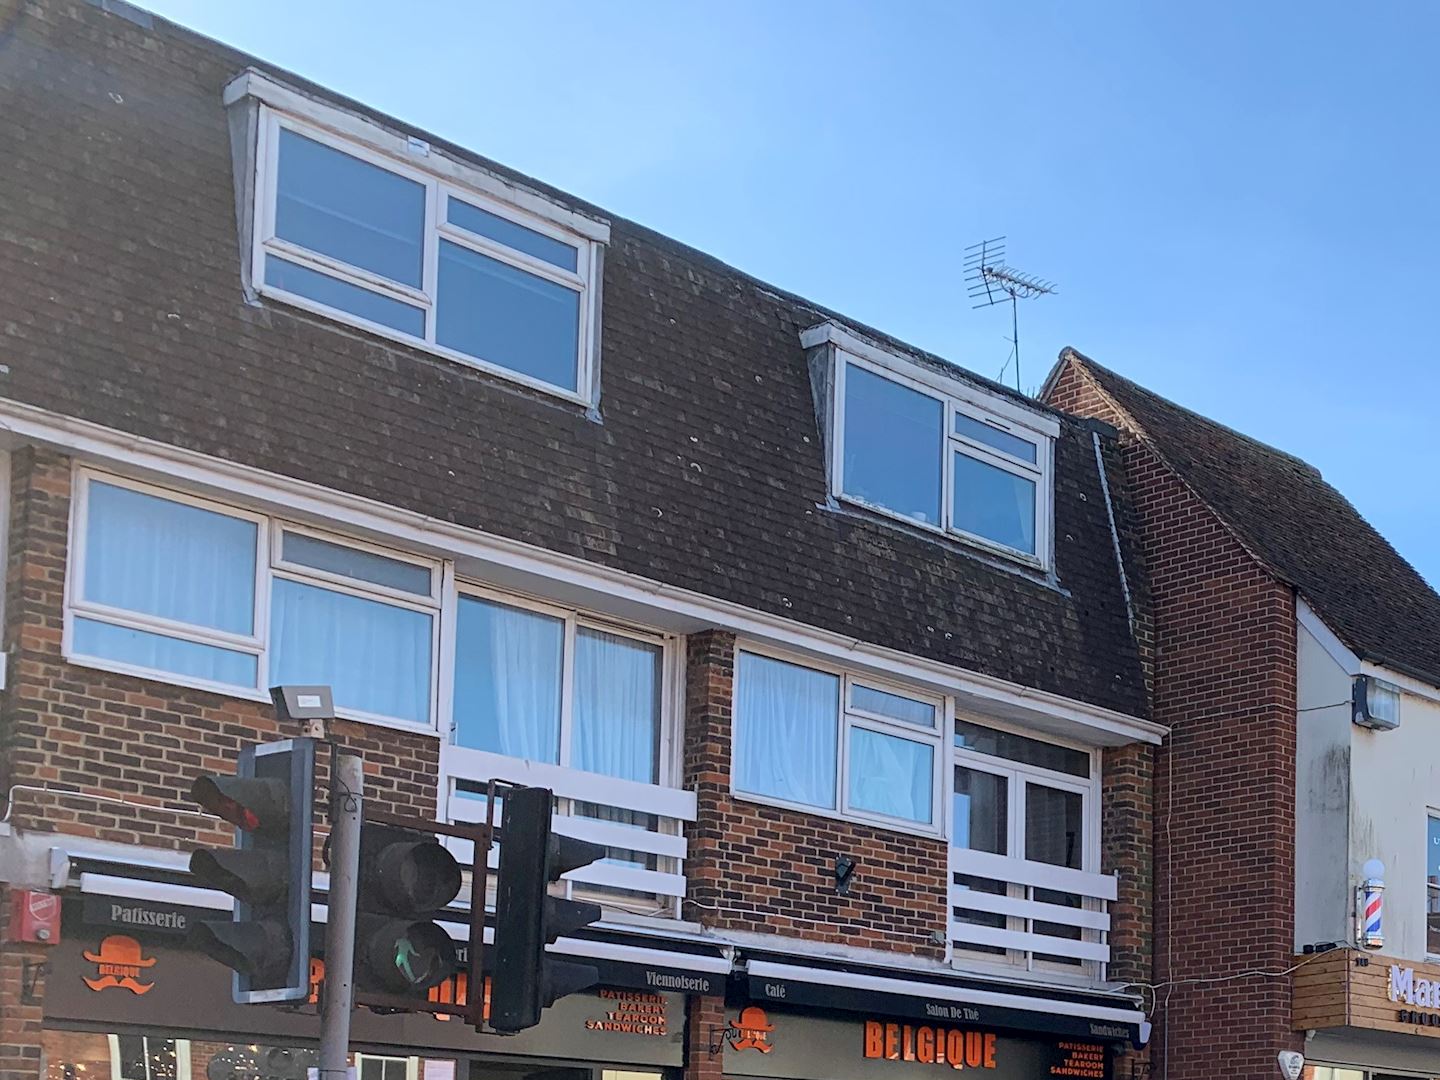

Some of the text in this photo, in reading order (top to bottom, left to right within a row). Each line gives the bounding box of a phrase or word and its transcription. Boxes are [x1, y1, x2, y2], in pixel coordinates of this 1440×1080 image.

[111, 904, 186, 929] Patisserie
[646, 970, 710, 992] Viennoiserie
[599, 989, 668, 1004] PATISSERIE
[765, 983, 786, 998] Café
[619, 1002, 666, 1015] BAKERY
[926, 1003, 979, 1021] Salon De Thé
[606, 1011, 666, 1025] TEAROOM
[586, 1019, 668, 1036] SANDWICHES
[1089, 1023, 1129, 1038] Sandwiches
[864, 1020, 997, 1070] BELGIQUE
[1058, 1041, 1104, 1052] PATISSERIE
[1063, 1059, 1104, 1069] TEAROOM
[1072, 1052, 1104, 1061] BAKERY
[1050, 1066, 1104, 1078] SANDWICHES
